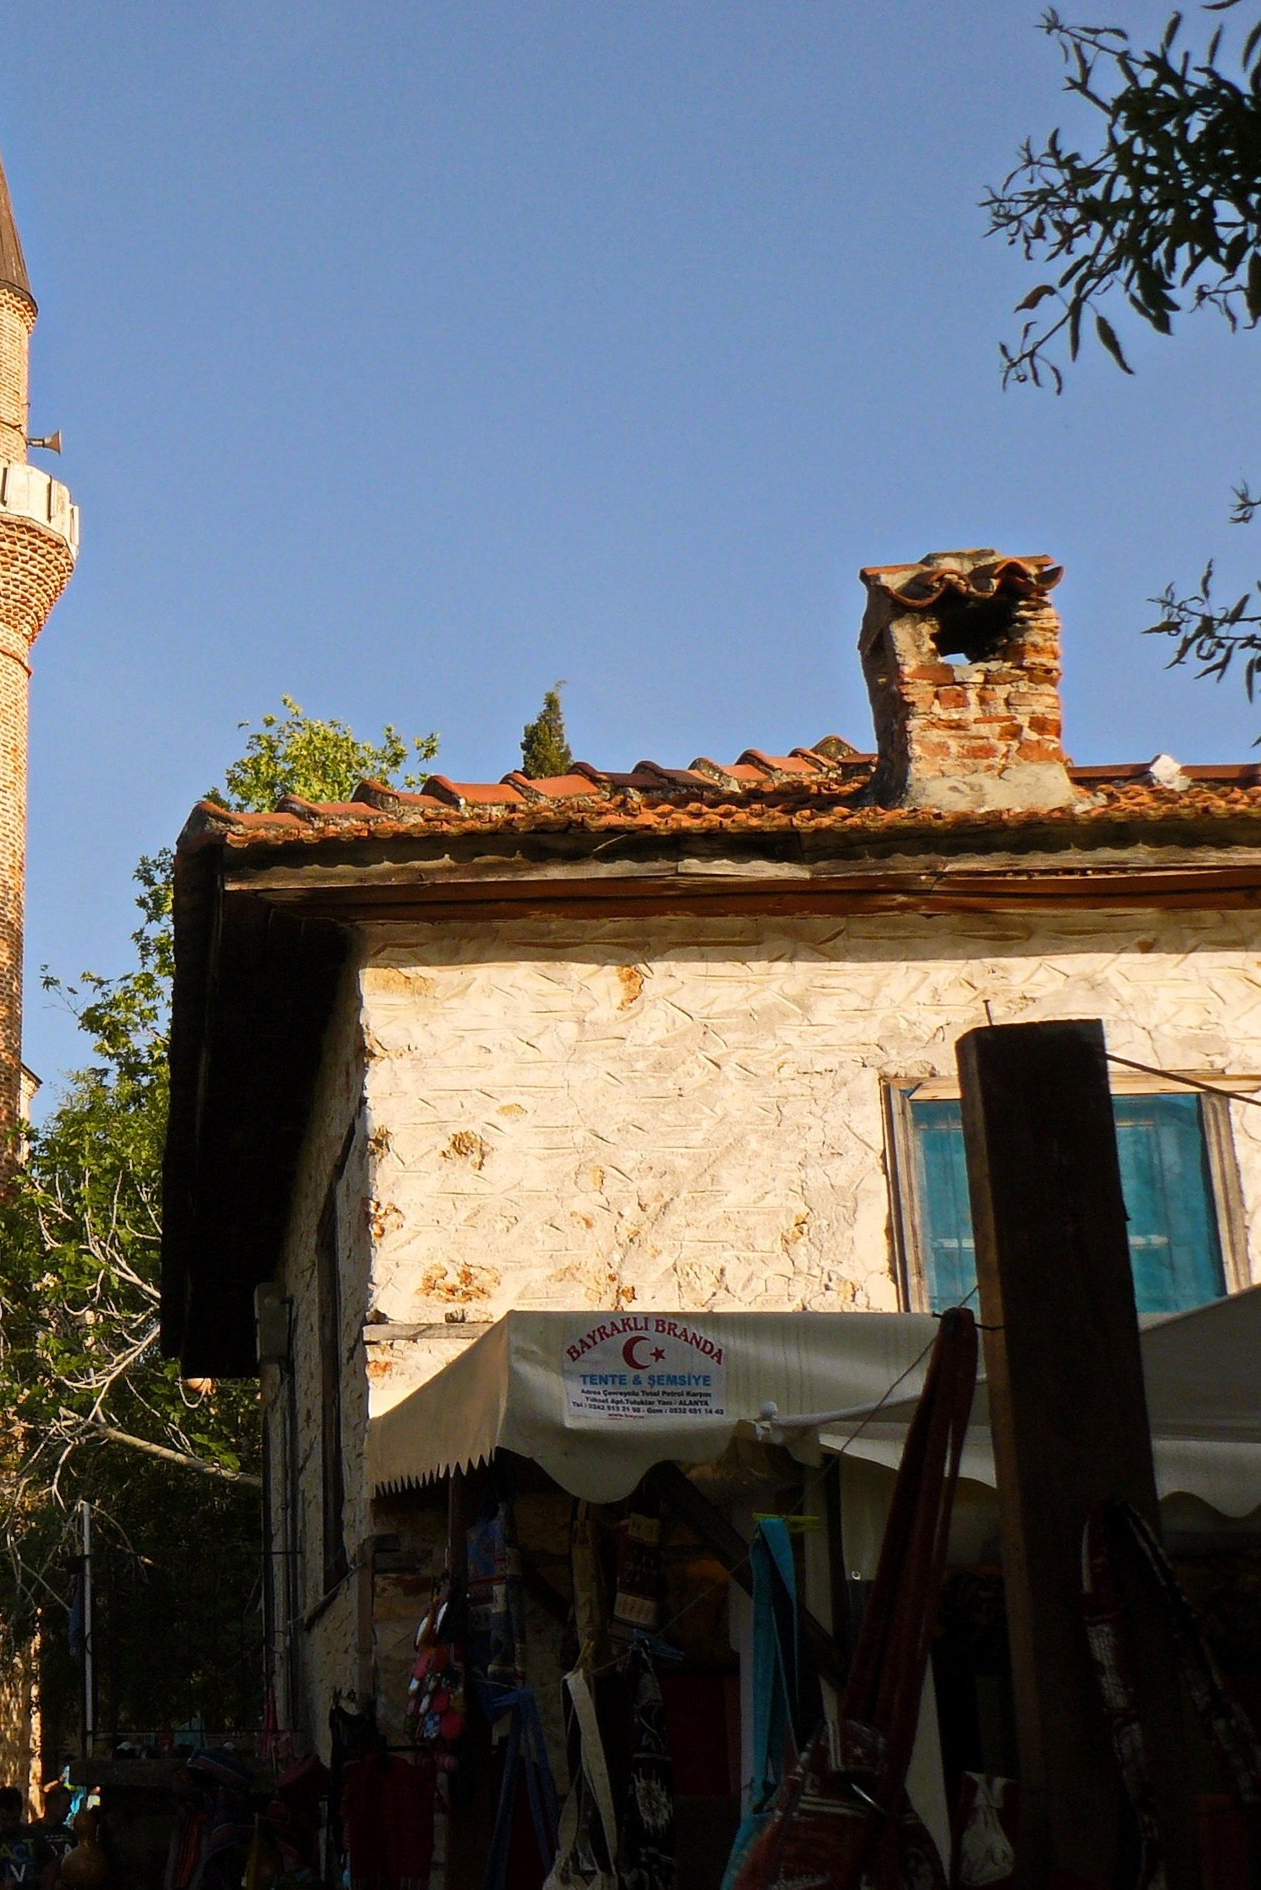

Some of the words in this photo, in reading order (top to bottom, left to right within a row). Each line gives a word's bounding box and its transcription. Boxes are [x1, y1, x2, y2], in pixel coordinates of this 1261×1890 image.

[566, 1316, 649, 1362] BAYRAKLI
[655, 1319, 724, 1365] BRANDA
[580, 1374, 627, 1386] TENTE
[632, 1375, 642, 1386] &
[647, 1372, 711, 1389] ŞEMSİYE
